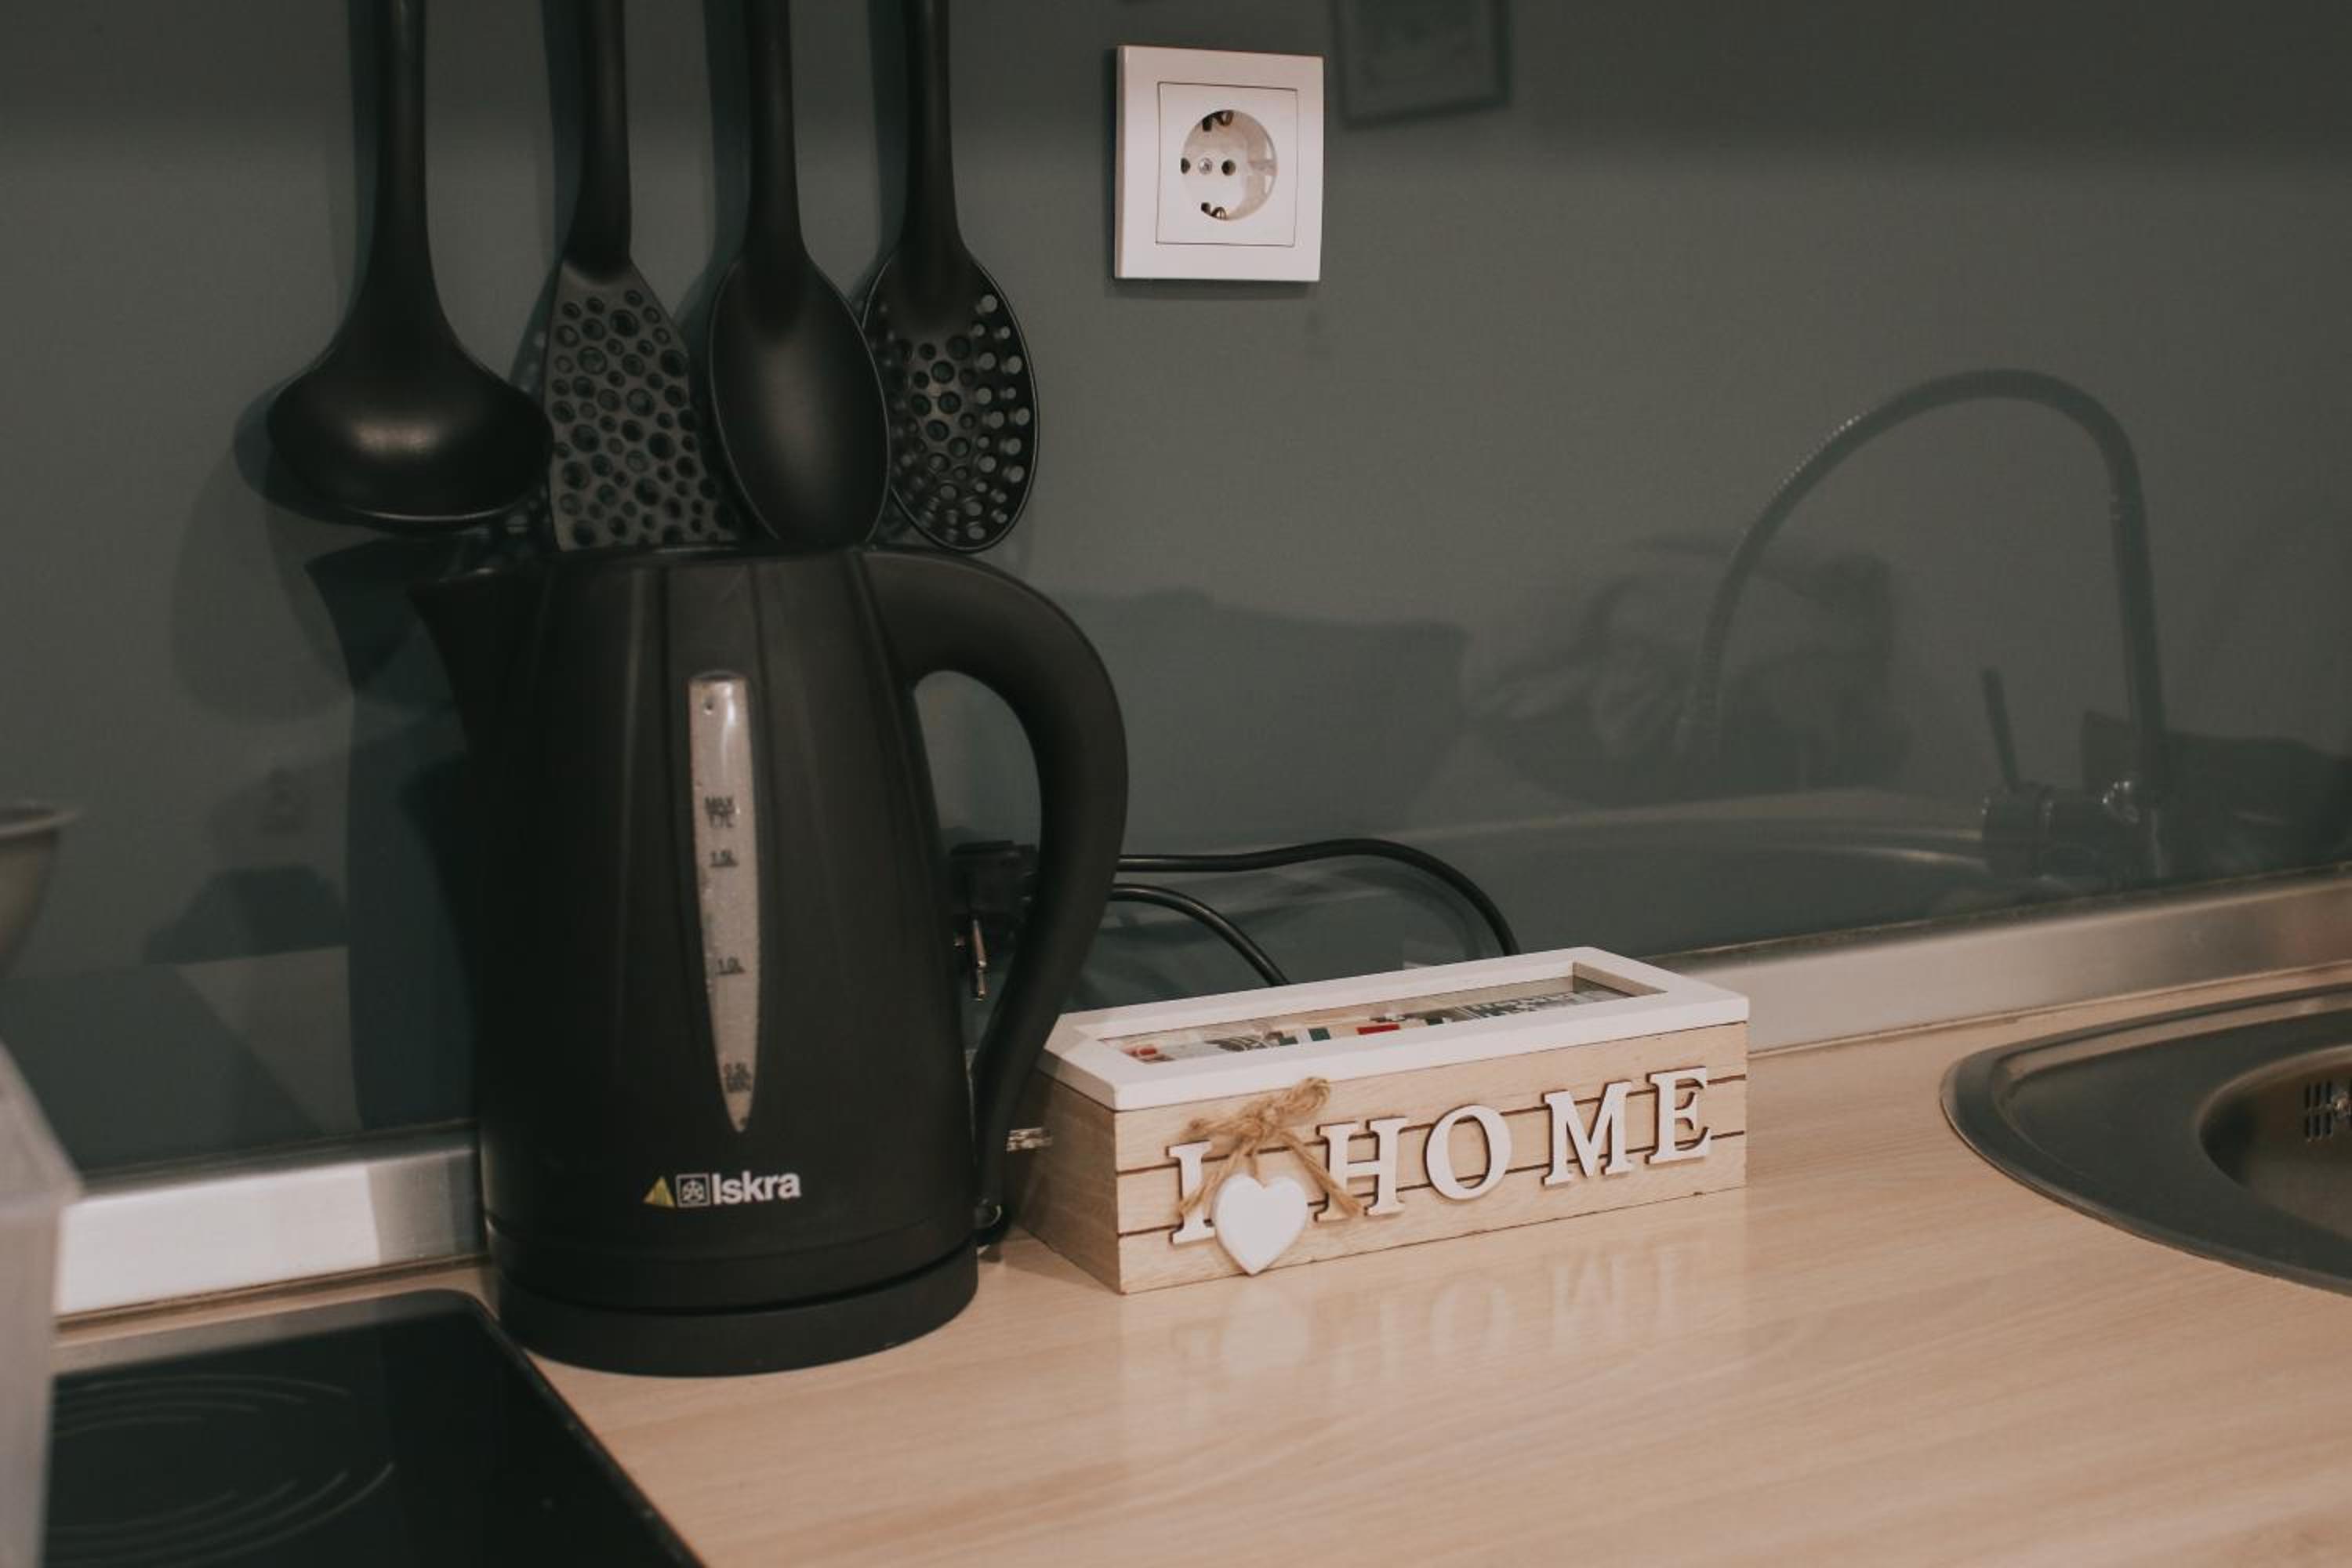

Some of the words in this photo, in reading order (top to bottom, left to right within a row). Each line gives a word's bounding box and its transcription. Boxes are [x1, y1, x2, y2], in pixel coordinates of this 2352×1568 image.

[711, 1171, 801, 1205] Iskra
[1167, 1141, 1217, 1245] I
[1312, 1065, 1712, 1222] HOME
